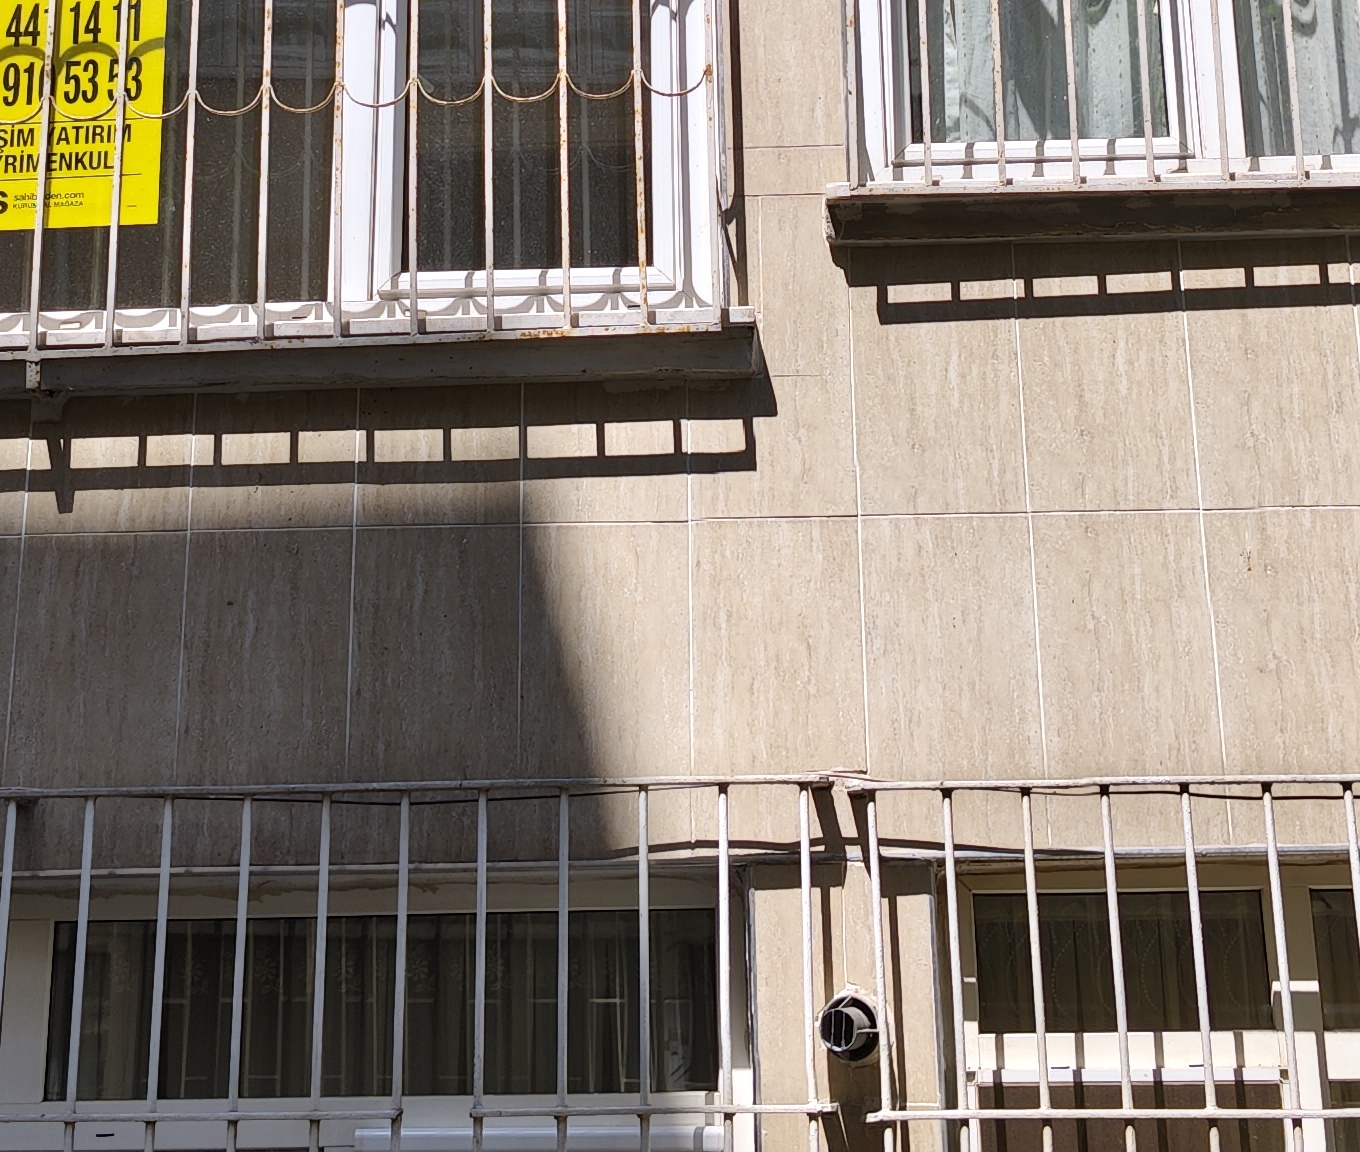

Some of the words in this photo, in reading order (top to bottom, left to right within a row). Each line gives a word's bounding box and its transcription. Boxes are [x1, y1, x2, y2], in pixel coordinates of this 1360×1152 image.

[6, 3, 51, 47] 44
[69, 0, 101, 44] 14
[63, 59, 98, 104] 53
[107, 56, 143, 102] 53
[13, 191, 85, 202] sahibden.com
